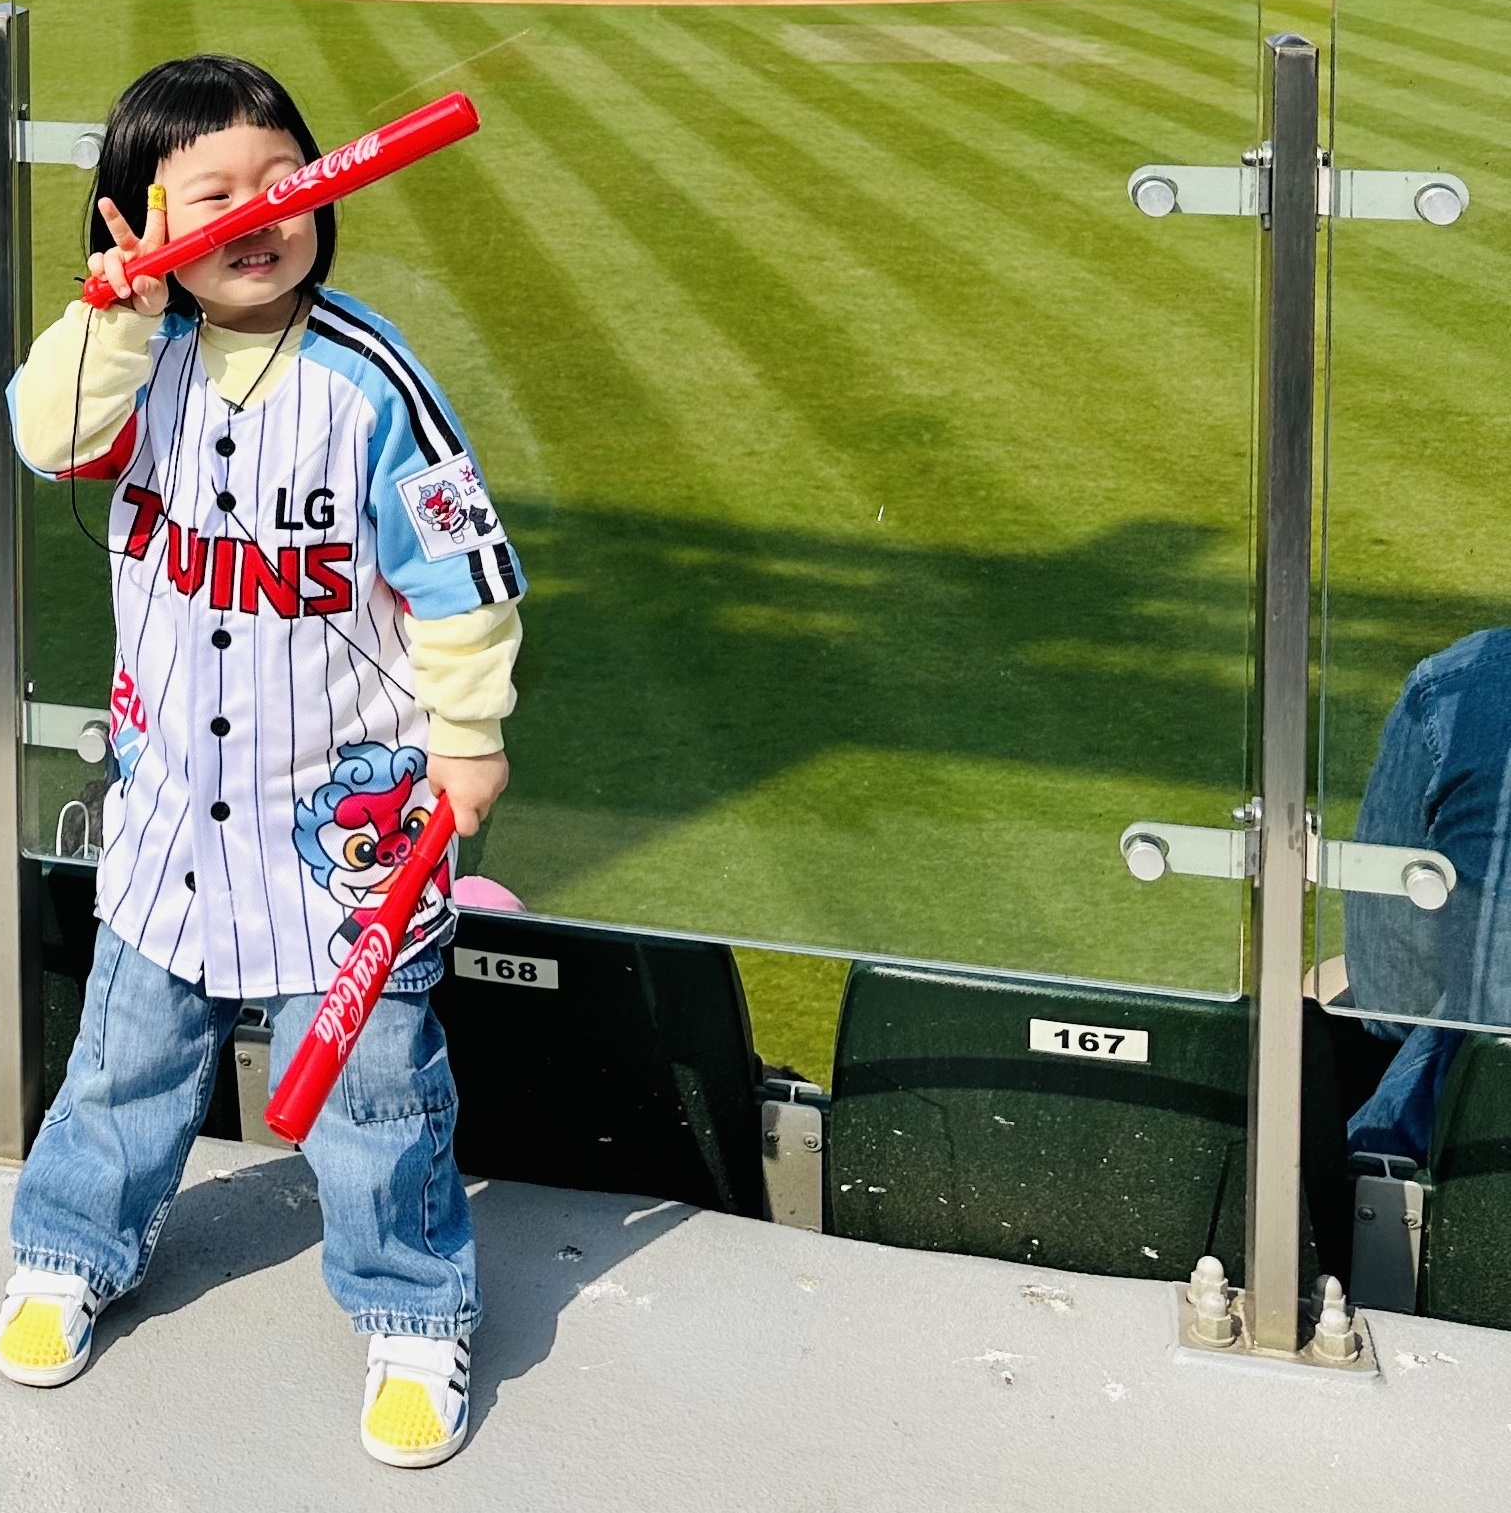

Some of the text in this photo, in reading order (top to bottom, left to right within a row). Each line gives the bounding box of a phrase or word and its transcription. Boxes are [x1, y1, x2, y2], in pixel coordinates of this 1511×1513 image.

[275, 488, 336, 531] LG
[122, 483, 353, 620] TWINS
[473, 955, 538, 983] 168
[1053, 1028, 1126, 1055] 167
